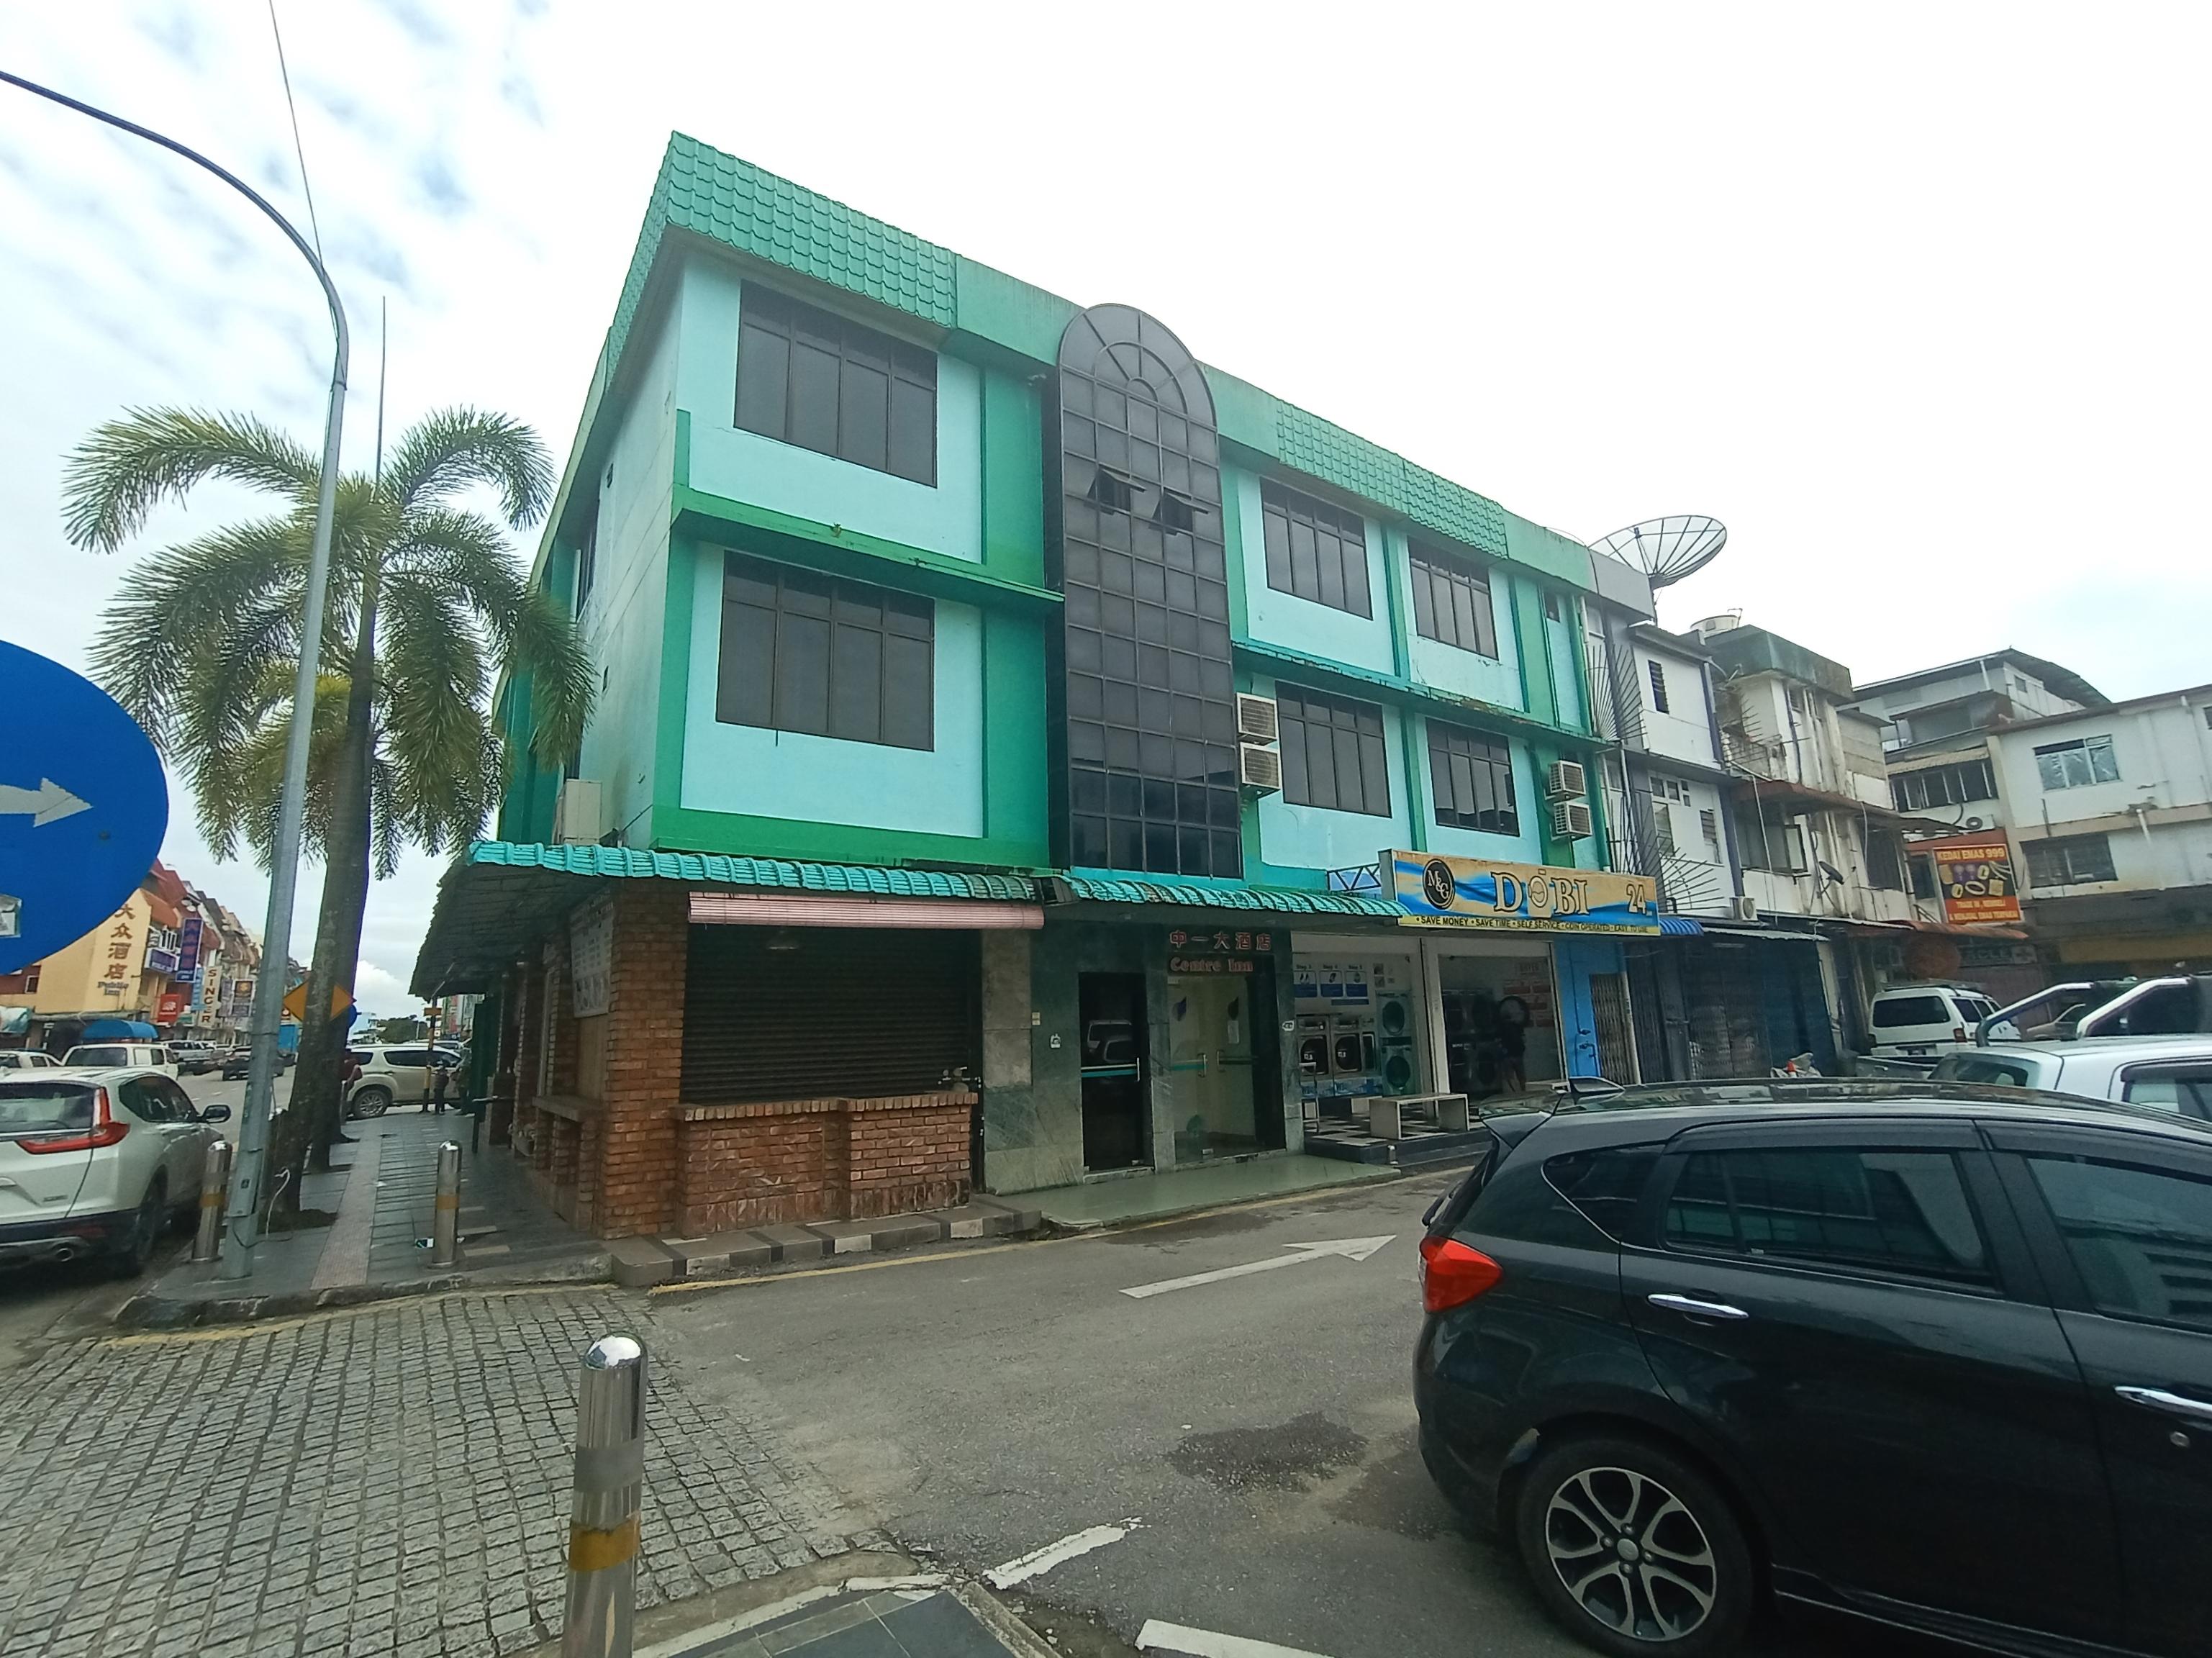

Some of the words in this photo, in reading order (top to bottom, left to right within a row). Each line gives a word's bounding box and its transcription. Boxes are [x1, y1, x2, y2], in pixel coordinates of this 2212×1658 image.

[1986, 848, 2005, 858] 999
[1626, 883, 1646, 915] 24
[1420, 916, 1441, 925] SAVE
[1442, 917, 1469, 926] MONEY
[1475, 918, 1493, 927] SAVE
[1516, 920, 1533, 928] SELF
[1534, 920, 1561, 929] SERVICE
[104, 903, 135, 979] 大众酒店
[1169, 929, 1272, 951] 中一大酒店
[1170, 956, 1221, 972] Centre
[1228, 958, 1254, 972] Inn
[201, 969, 217, 1023] SINGER
